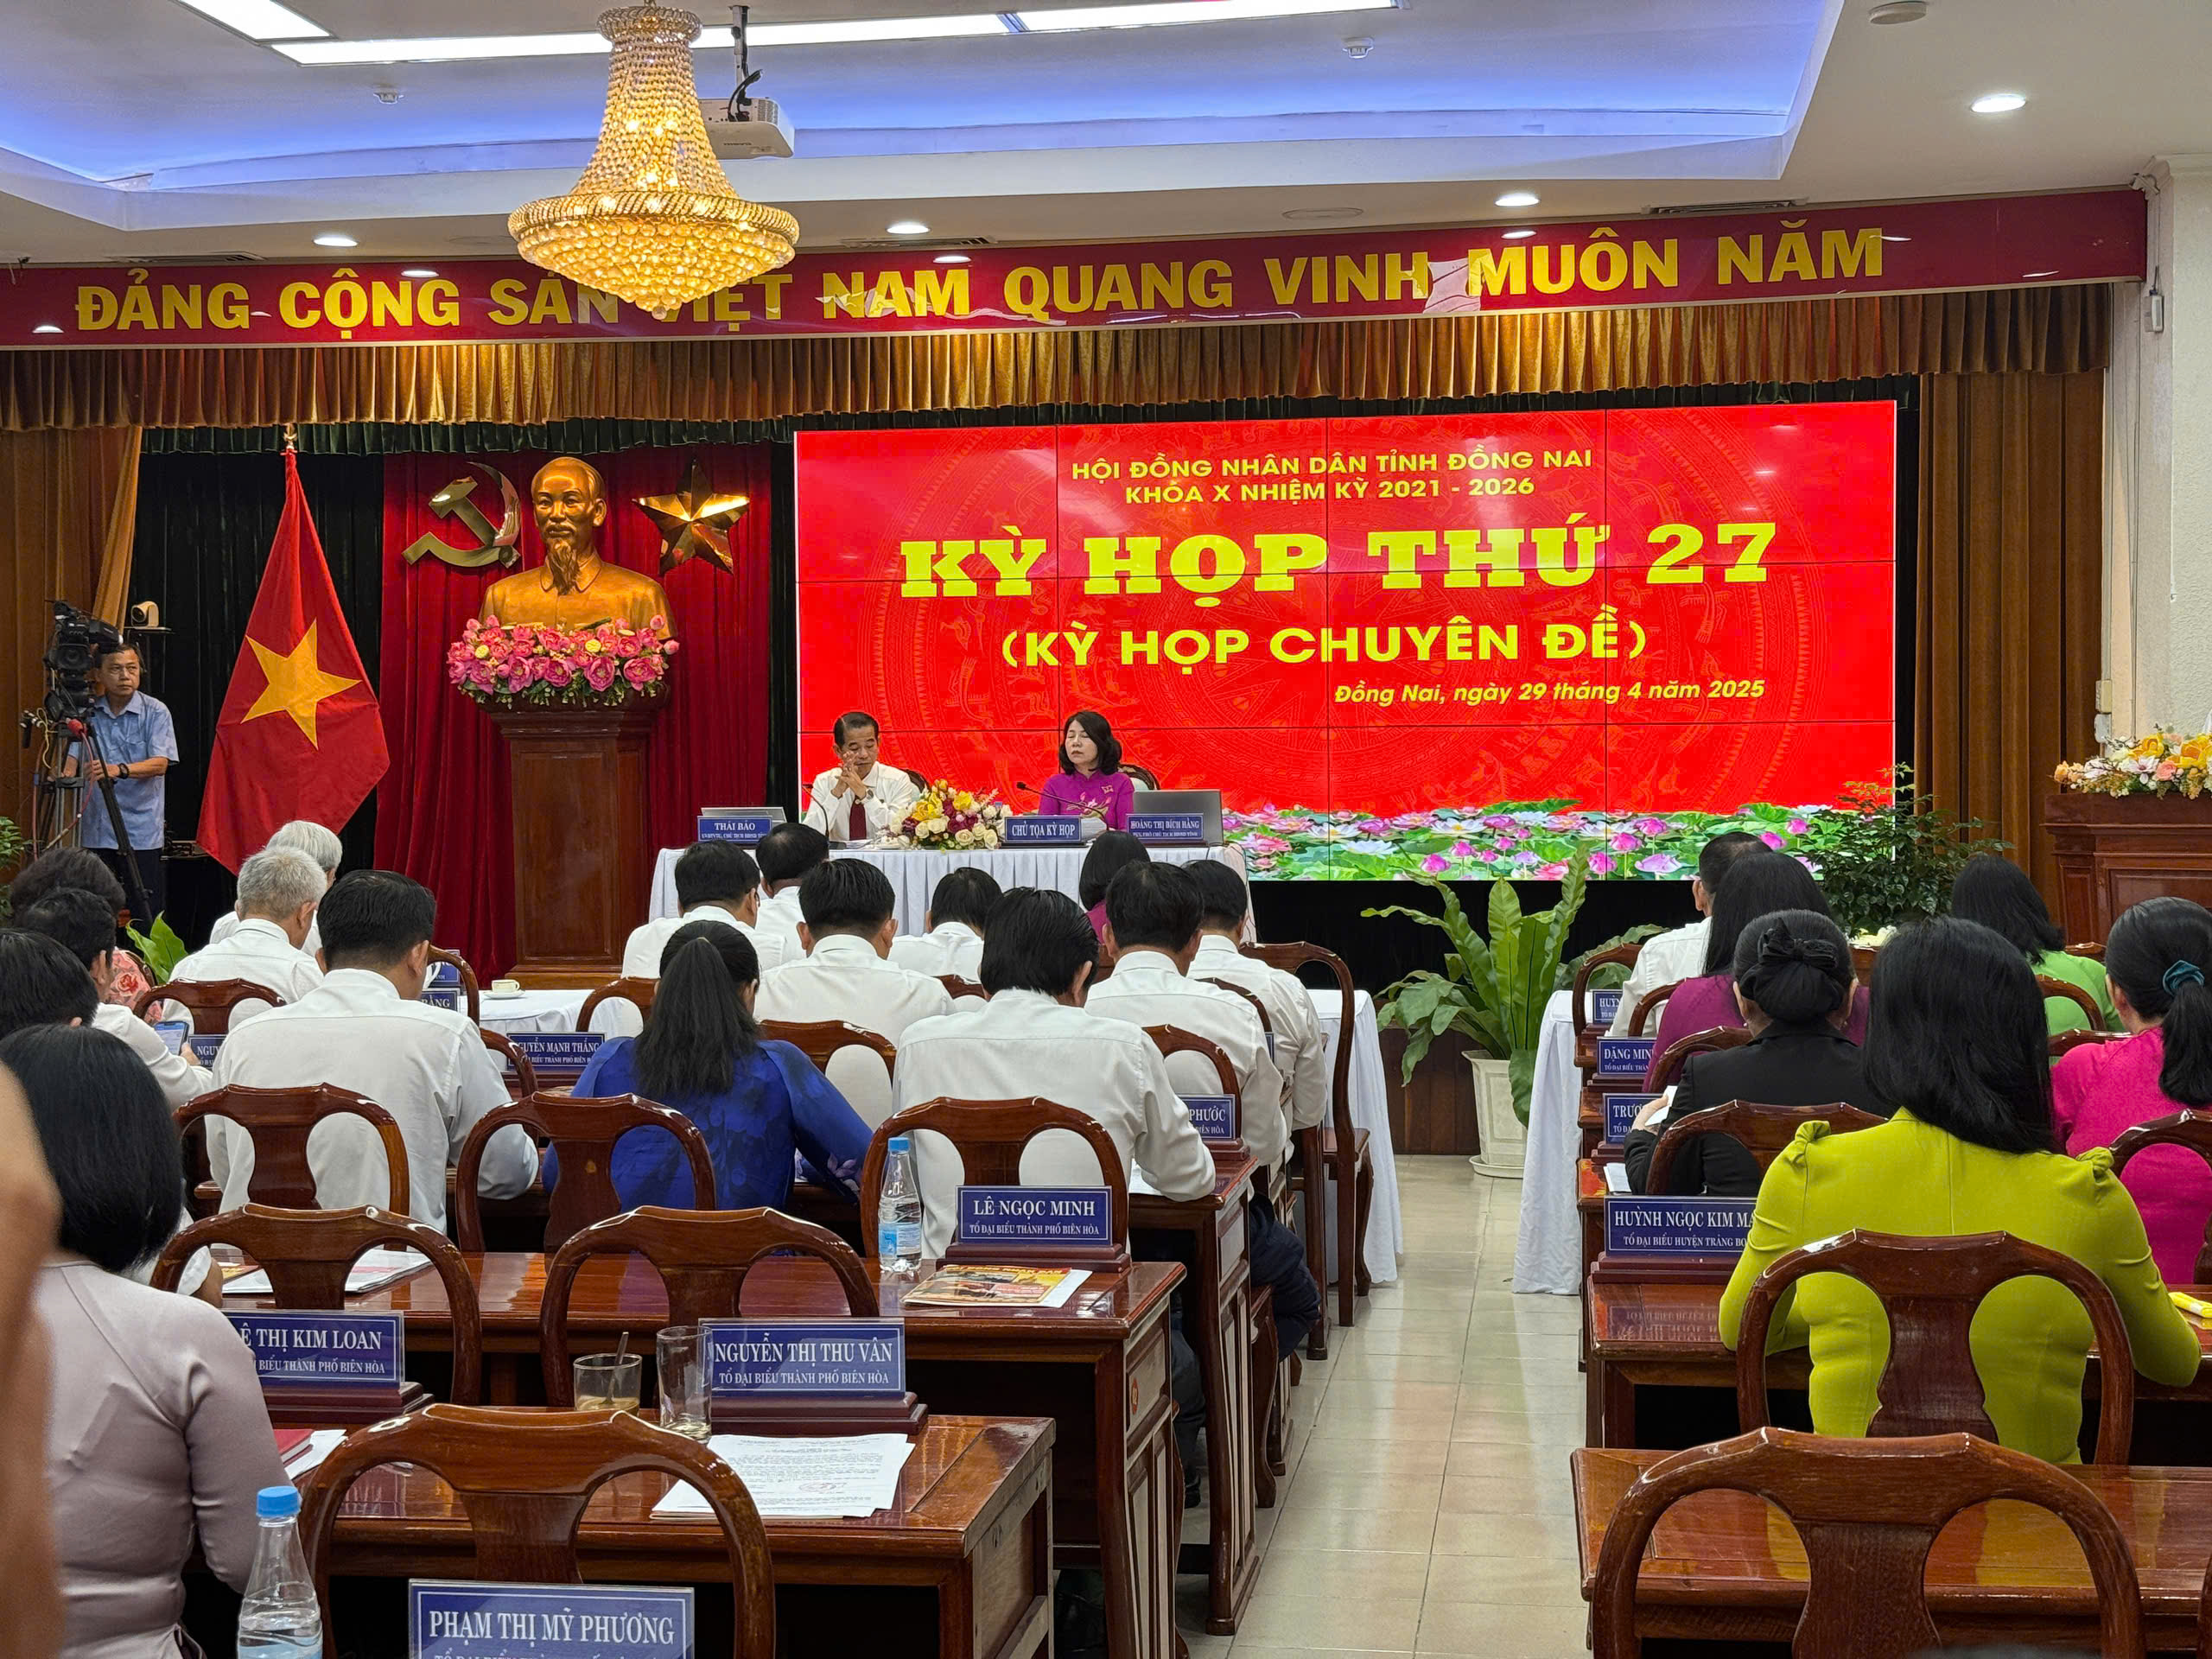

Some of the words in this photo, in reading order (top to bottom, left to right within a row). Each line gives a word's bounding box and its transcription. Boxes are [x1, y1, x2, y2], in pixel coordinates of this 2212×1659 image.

[75, 268, 251, 330] ĐẢNG
[279, 267, 460, 339] CỘNG
[660, 274, 793, 332] IỆT
[822, 269, 970, 319] NAM
[1003, 258, 1233, 322] QUANG
[1263, 251, 1429, 305] VINH
[1467, 226, 1678, 296] MUÔN
[1718, 219, 1883, 285] NĂM
[1072, 457, 1120, 484] HỘI
[1129, 451, 1212, 478] ĐỒNG
[1222, 454, 1300, 475] NHÂN
[1309, 452, 1367, 474] DÂN
[1376, 448, 1437, 472] TỈNH
[1446, 443, 1534, 470] ĐỒNG
[1543, 448, 1592, 467] NAI
[1126, 479, 1204, 504] KHÓA
[1211, 485, 1231, 502] X
[1241, 479, 1325, 505] NHIỆM
[1335, 476, 1369, 499] KỲ
[1378, 480, 1440, 498] 2021
[1469, 477, 1535, 496] 2026
[900, 525, 1046, 598] KỲ
[1084, 534, 1328, 607] HỌP
[1367, 512, 1611, 589] THỨ
[1646, 522, 1777, 584] 27
[1002, 620, 1098, 668] (KỲ
[1121, 628, 1249, 675] HỌP
[1269, 614, 1519, 664] CHUYÊN
[1541, 602, 1647, 660] ĐỀ)
[1334, 678, 1395, 707] Đồng
[1402, 684, 1445, 705] Nai,
[1453, 683, 1512, 707] ngày
[1517, 682, 1547, 701] 29
[1553, 681, 1620, 705] tháng
[1627, 681, 1642, 699] 4
[1648, 679, 1700, 699] năm
[1707, 679, 1766, 698] 2025
[1012, 820, 1027, 836] CHỦ
[1029, 824, 1045, 838] TỌA
[1046, 821, 1058, 836] KỲ
[1059, 824, 1076, 838] HỌP
[518, 1037, 544, 1052] GUYỄN
[547, 1043, 569, 1054] MẠNH
[1604, 1046, 1630, 1062] ĐẶNG
[1633, 1048, 1654, 1059] MIN
[1189, 1105, 1226, 1121] PHƯỚC
[974, 1196, 995, 1216] LÊ
[999, 1200, 1046, 1220] NGỌC
[1050, 1201, 1096, 1217] MINH
[1615, 1205, 1662, 1226] HUỲNH
[1666, 1211, 1704, 1231] NGỌC
[1707, 1212, 1733, 1227] KIM
[969, 1220, 981, 1234] TỔ
[982, 1224, 995, 1236] ĐẠI
[996, 1220, 1014, 1234] BIỂU
[1015, 1222, 1043, 1235] THÀNH
[1045, 1222, 1061, 1235] PHỐ
[1063, 1223, 1080, 1235] BIÊN
[1083, 1224, 1099, 1235] HÒA
[1624, 1231, 1635, 1245] TỔ
[1637, 1236, 1651, 1248] ĐẠI
[1654, 1232, 1673, 1246] BIỂU
[1675, 1234, 1703, 1248] HUYỆN
[1735, 1237, 1747, 1247] BO
[240, 1323, 251, 1348] Ê
[256, 1328, 289, 1352] THỊ
[293, 1329, 328, 1349] KIM
[332, 1330, 383, 1350] LOAN
[715, 1332, 784, 1363] NGUYỄN
[787, 1343, 817, 1367] THỊ
[820, 1343, 855, 1363] THU
[858, 1337, 893, 1362] VÂN
[259, 1354, 282, 1371] BIỂU
[284, 1358, 316, 1372] THÀNH
[318, 1357, 339, 1373] PHỐ
[340, 1359, 363, 1373] BIÊN
[365, 1361, 385, 1374] HÒA
[719, 1367, 733, 1384] TỔ
[734, 1372, 753, 1387] ĐẠI
[754, 1367, 778, 1384] BIỂU
[781, 1369, 816, 1384] THÀNH
[818, 1369, 840, 1384] PHỐ
[868, 1370, 889, 1384] HÒA
[429, 1610, 493, 1646] PHẠM
[498, 1612, 537, 1648] THỊ
[541, 1607, 574, 1642] MỸ
[580, 1611, 675, 1645] PHƯƠNG
